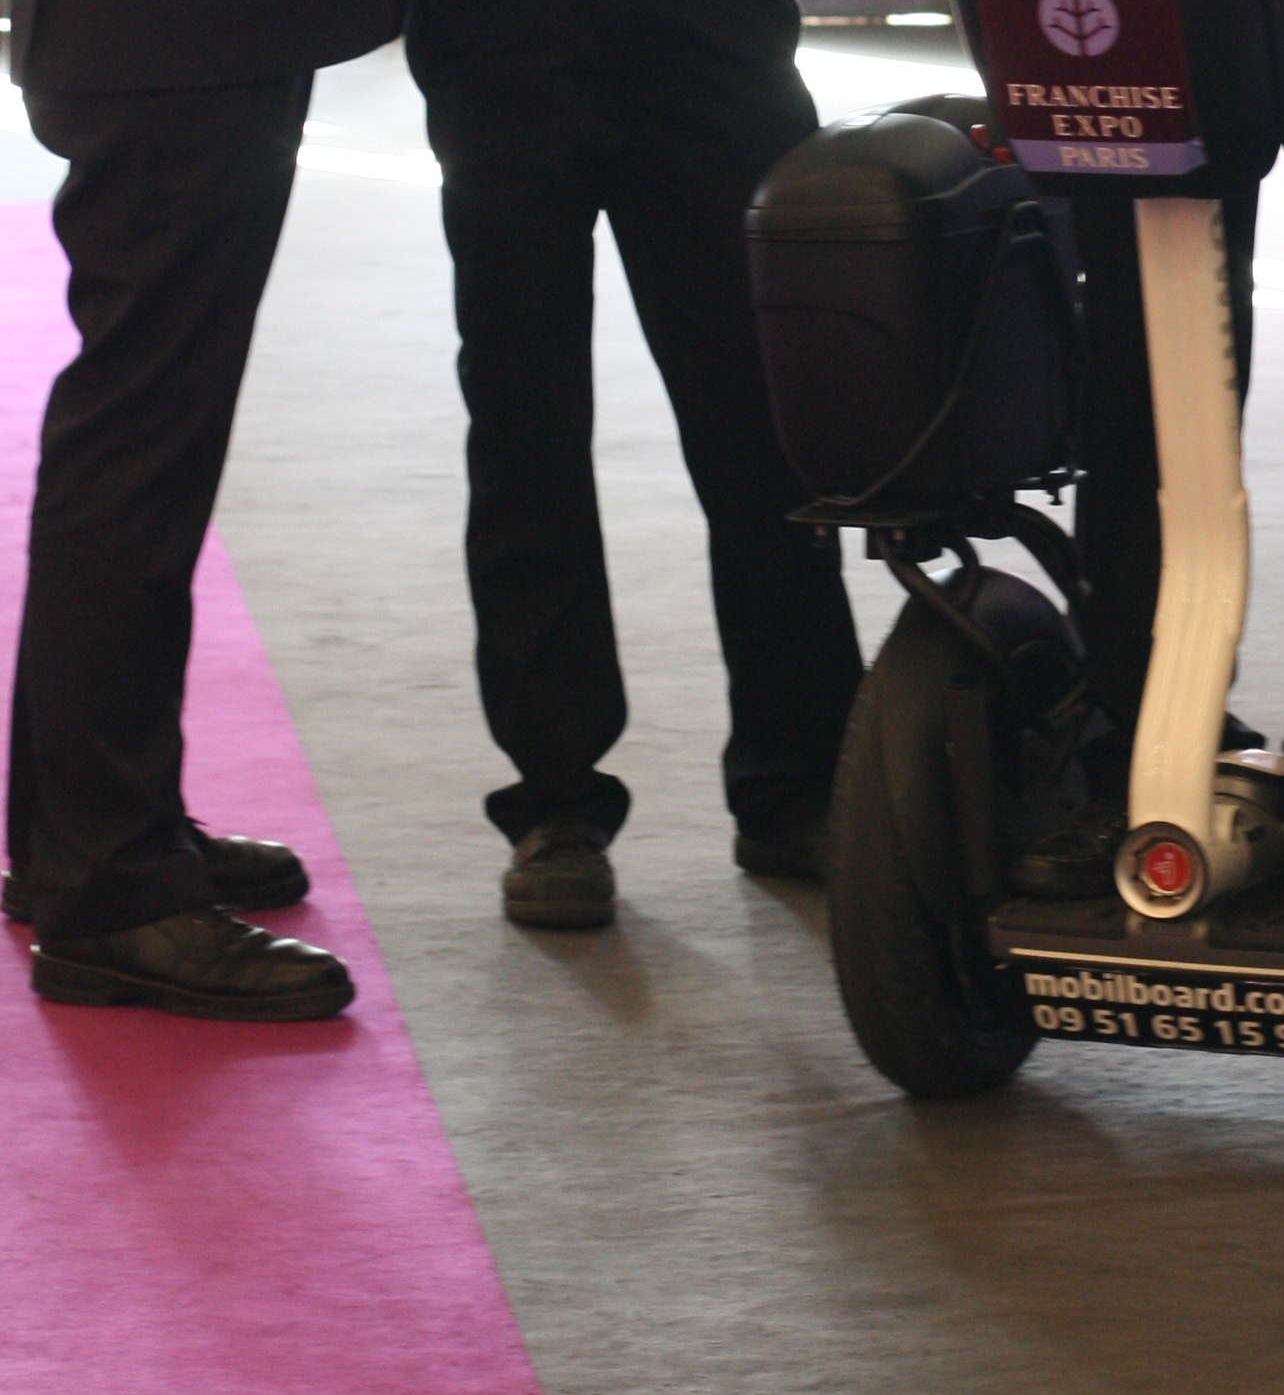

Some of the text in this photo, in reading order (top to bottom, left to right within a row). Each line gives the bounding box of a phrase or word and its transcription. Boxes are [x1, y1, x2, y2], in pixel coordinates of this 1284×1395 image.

[1006, 83, 1183, 109] FRANCHISE
[1051, 114, 1144, 138] EXPO
[1057, 146, 1150, 169] PARIS
[1032, 1004, 1086, 1032] 09
[1092, 1008, 1140, 1038] 51
[1151, 1014, 1205, 1043] 65
[1214, 1020, 1266, 1047] 15
